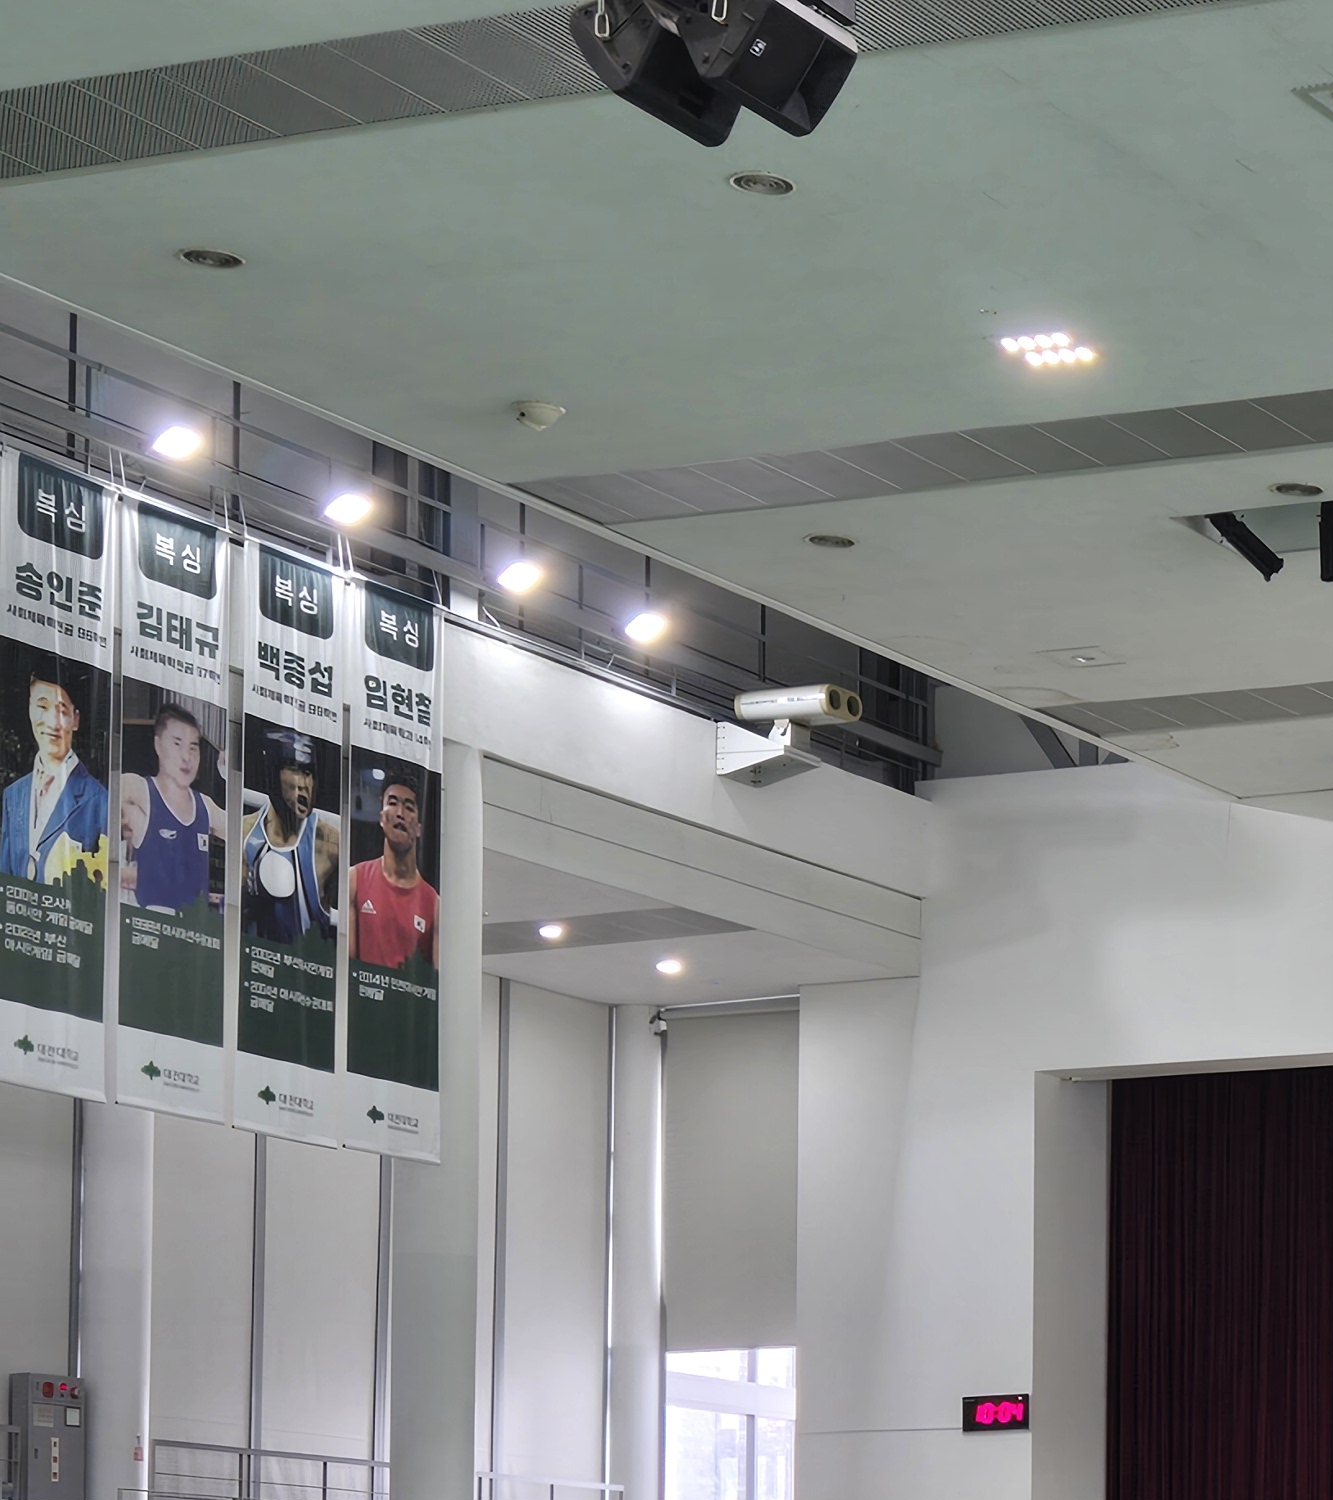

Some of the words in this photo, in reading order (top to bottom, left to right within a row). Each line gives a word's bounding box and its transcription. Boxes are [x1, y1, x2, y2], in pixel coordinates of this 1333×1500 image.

[36, 489, 86, 533] 복싱
[155, 532, 201, 575] 복싱
[15, 562, 102, 622] 송인준
[275, 575, 318, 615] 복싱
[136, 601, 219, 660] 김태규
[380, 610, 420, 648] 복싱
[364, 675, 432, 727] 임현철
